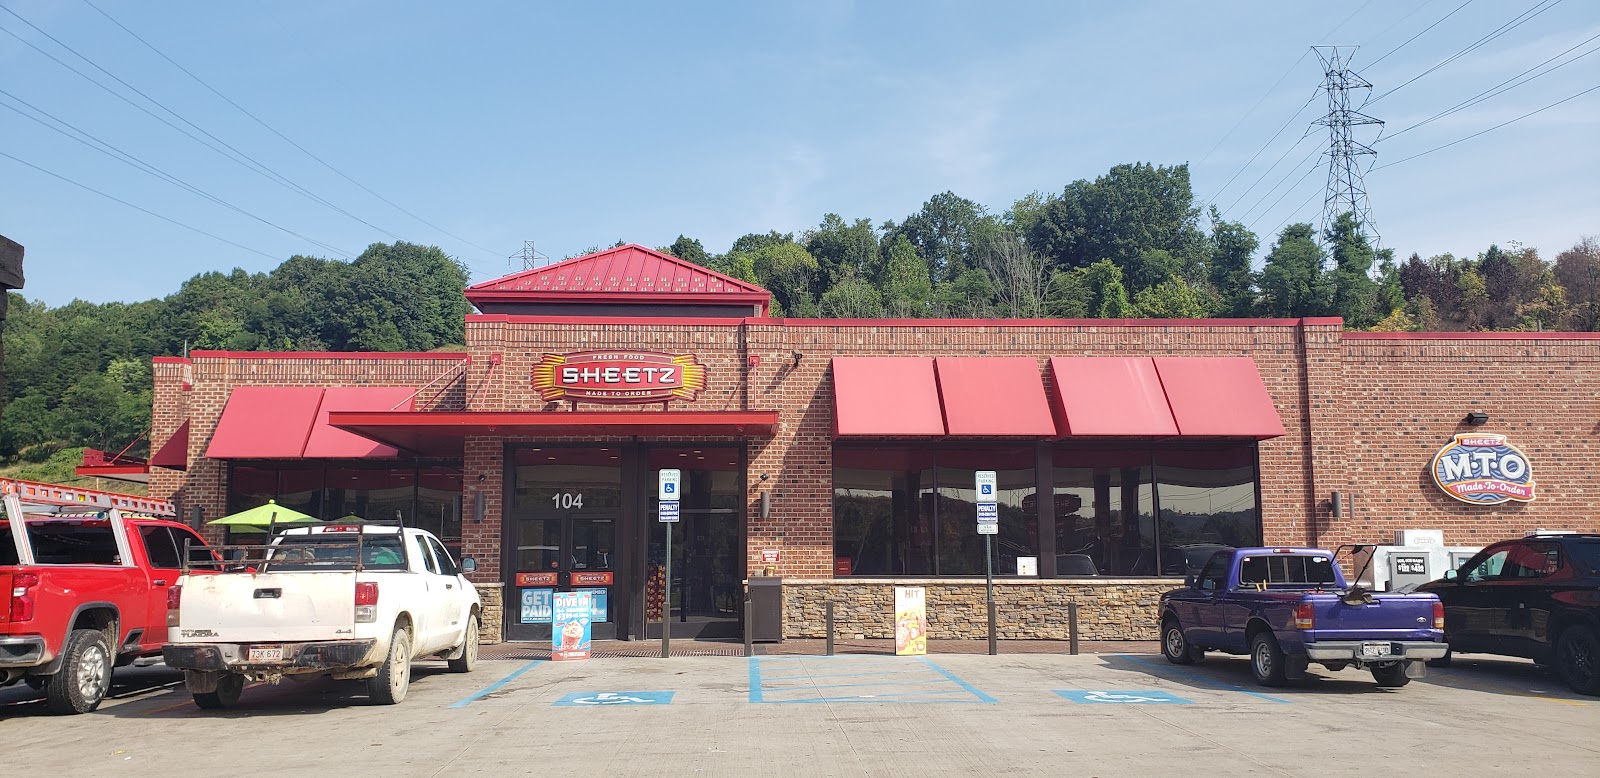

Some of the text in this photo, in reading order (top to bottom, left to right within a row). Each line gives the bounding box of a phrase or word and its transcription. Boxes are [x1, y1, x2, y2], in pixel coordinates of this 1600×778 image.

[562, 367, 675, 384] SHEETZ
[552, 492, 584, 509] 104
[522, 590, 551, 605] GET
[905, 589, 920, 598] HIT
[556, 597, 589, 607] DIVE IN
[522, 605, 553, 617] PAID
[251, 650, 281, 658] 73K 672
